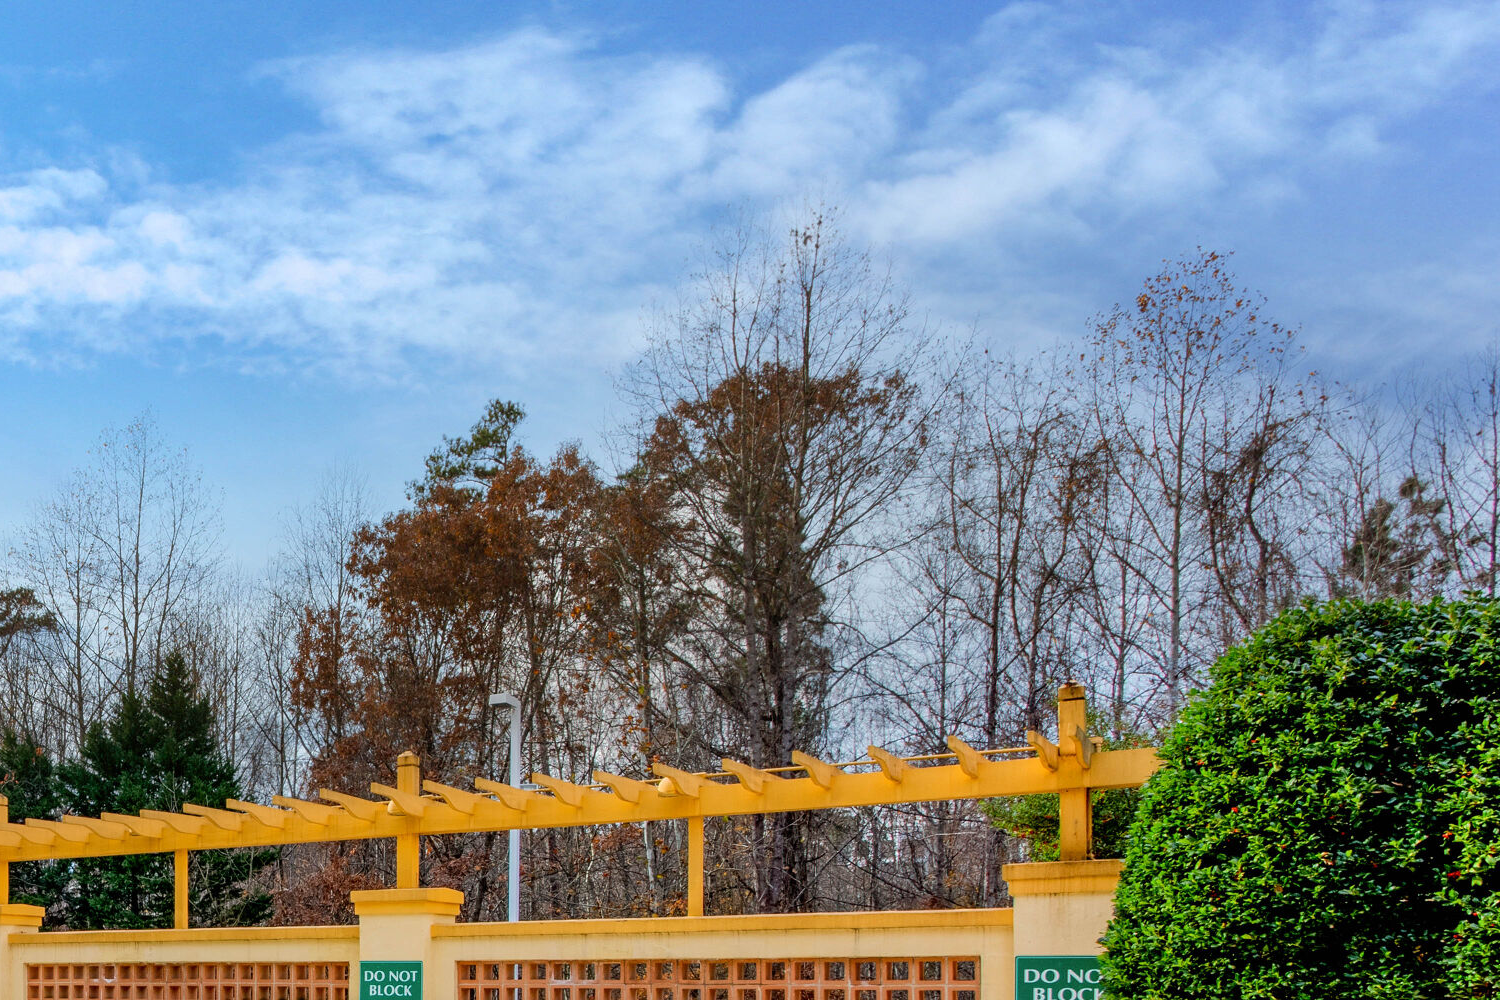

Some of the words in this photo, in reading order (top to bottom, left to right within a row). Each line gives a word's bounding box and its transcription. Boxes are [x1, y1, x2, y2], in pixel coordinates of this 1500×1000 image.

[364, 970, 385, 982] DO
[389, 970, 418, 982] NOT
[1023, 968, 1060, 984] DO
[1067, 968, 1103, 984] NO
[369, 984, 412, 997] BLOCK
